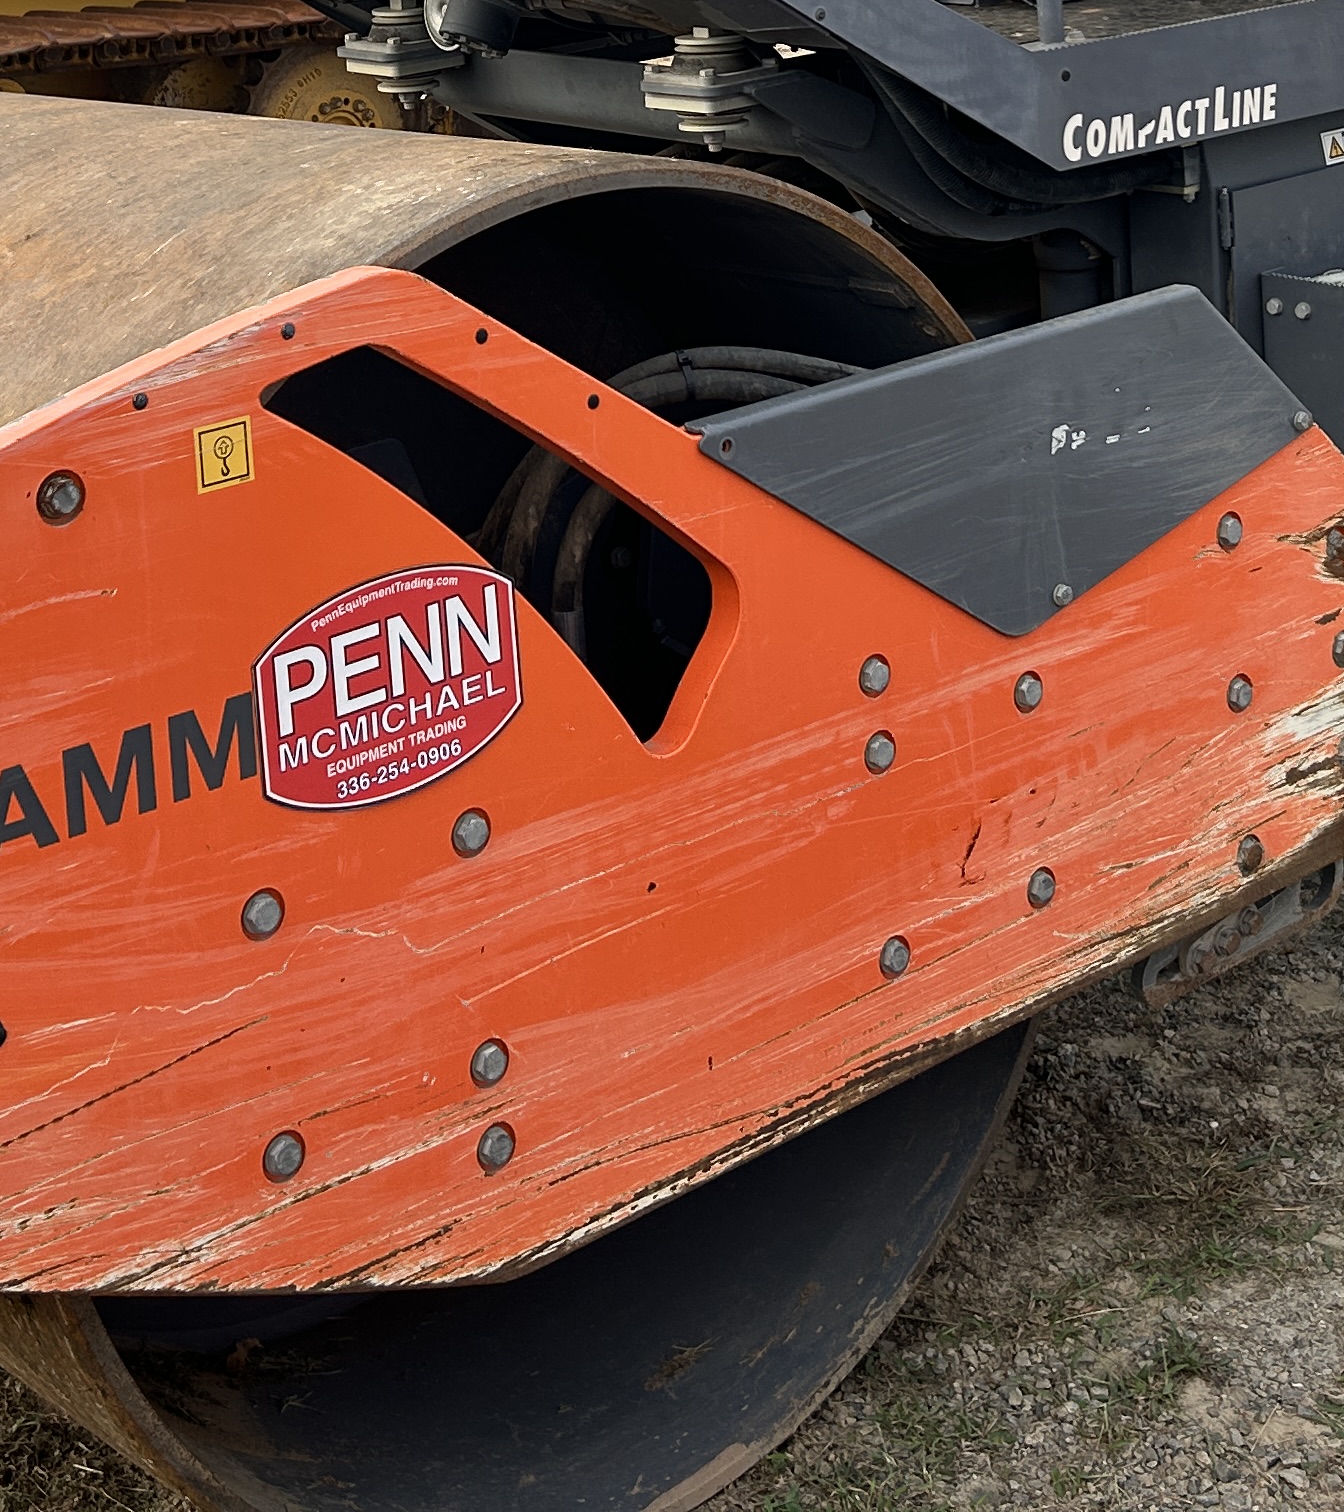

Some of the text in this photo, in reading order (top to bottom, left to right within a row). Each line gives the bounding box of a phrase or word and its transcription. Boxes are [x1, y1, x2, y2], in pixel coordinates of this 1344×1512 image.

[310, 575, 459, 633] PennEquipmentTrading.com
[272, 583, 503, 738] PENN
[278, 669, 507, 772] MCMICHAEL
[326, 715, 468, 778] EQUIPMENT TRADING
[336, 739, 463, 800] 336-254-0906
